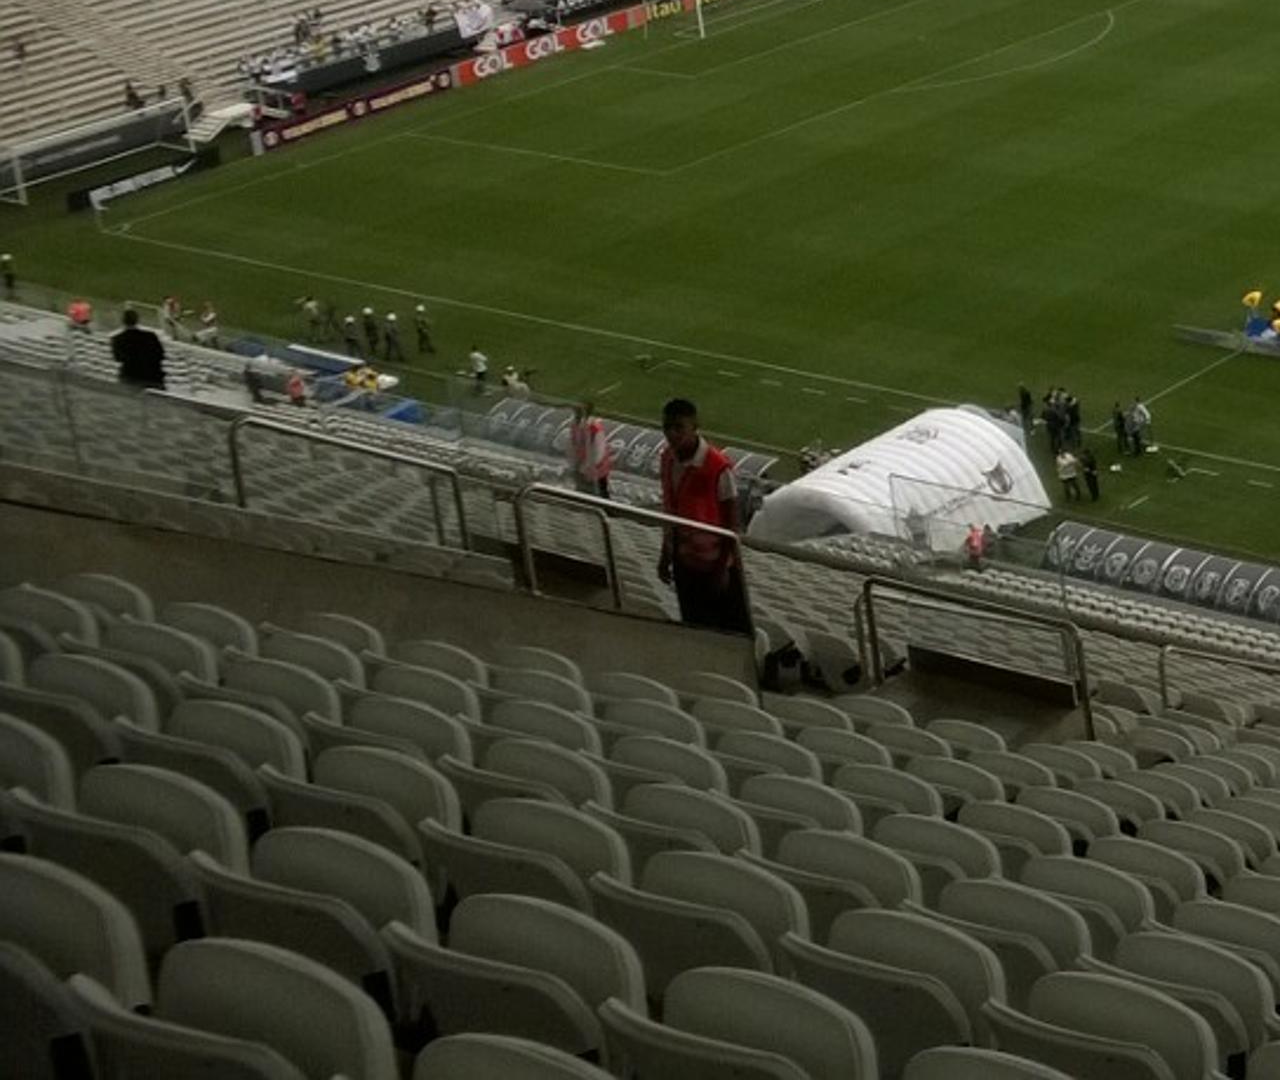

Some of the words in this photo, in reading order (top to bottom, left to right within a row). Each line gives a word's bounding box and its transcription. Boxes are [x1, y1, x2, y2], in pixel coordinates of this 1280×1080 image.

[576, 21, 614, 42] GOL
[526, 34, 565, 60] GOL
[473, 47, 513, 78] GOL
